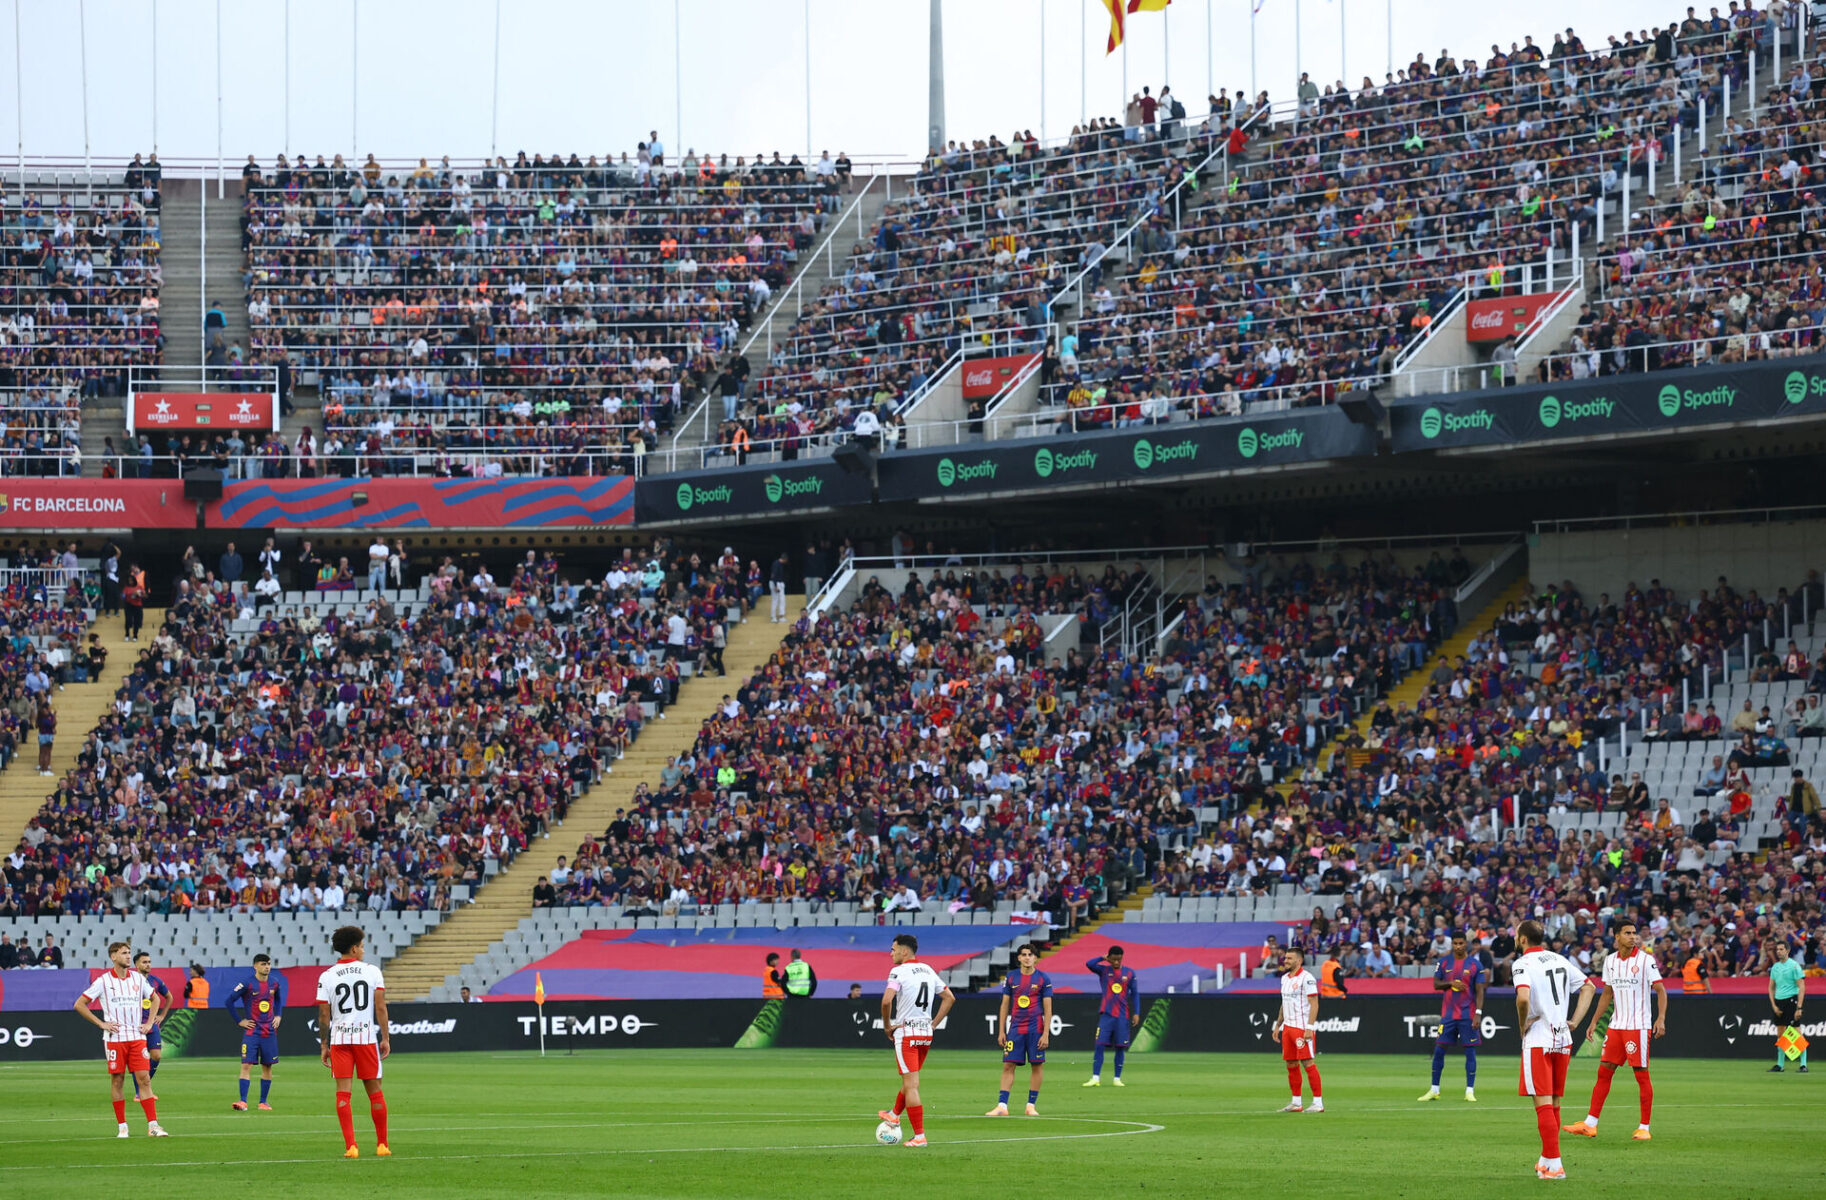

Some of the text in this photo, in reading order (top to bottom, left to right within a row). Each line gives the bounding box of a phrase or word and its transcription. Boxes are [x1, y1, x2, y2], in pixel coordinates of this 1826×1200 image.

[1684, 386, 1736, 408] Spotify
[147, 413, 179, 421] ESTRELLA
[229, 413, 260, 421] ESTRELLA
[1564, 398, 1615, 420] Spotify
[1446, 411, 1494, 432] Spotify
[1260, 429, 1303, 450] Spotify
[1056, 450, 1097, 470] Spotify
[1153, 441, 1198, 462] Spotify
[957, 461, 996, 481] Spotify
[694, 486, 732, 504] Spotify
[784, 477, 822, 496] Spotify
[13, 497, 126, 512] FC BARCELONA
[336, 966, 363, 977] WITSEL
[335, 980, 369, 1014] 20
[915, 981, 929, 1012] 4
[1545, 967, 1568, 1006] 17
[517, 1014, 641, 1035] TIEMPO
